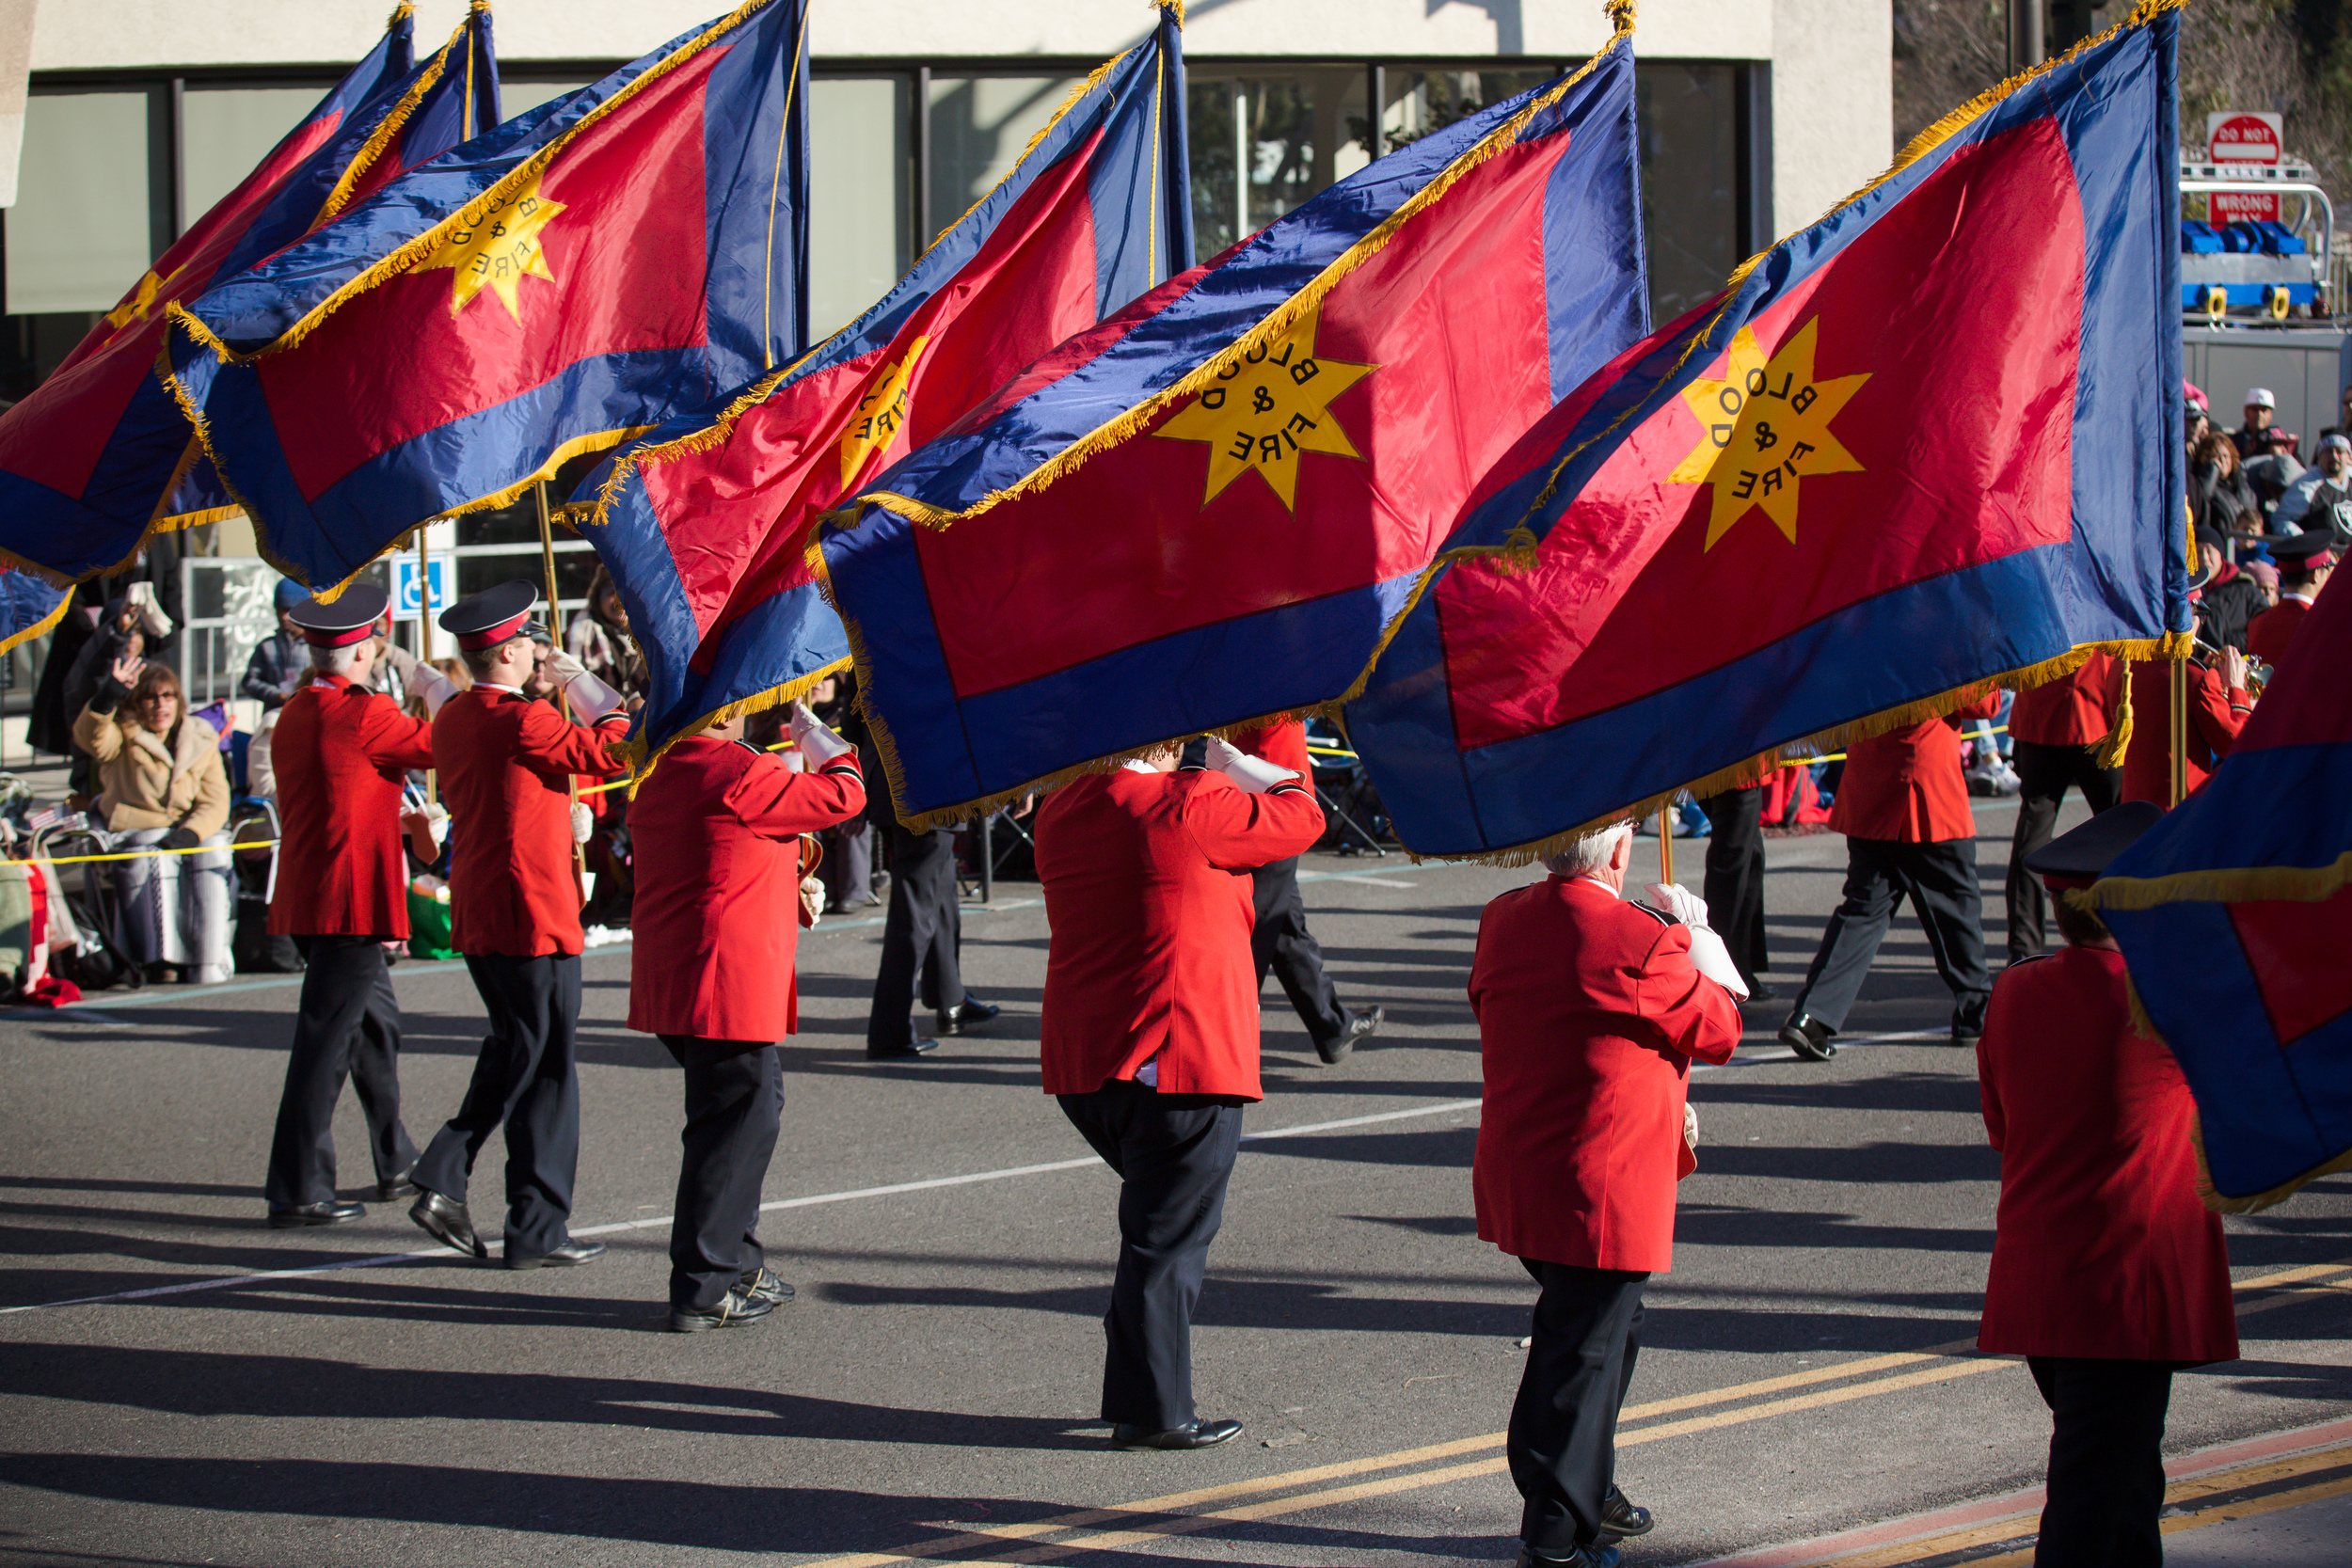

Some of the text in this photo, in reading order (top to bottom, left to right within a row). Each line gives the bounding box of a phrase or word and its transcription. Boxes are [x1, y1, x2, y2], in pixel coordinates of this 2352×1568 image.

[2218, 127, 2271, 142] DO NOT
[2216, 195, 2274, 213] WRONG
